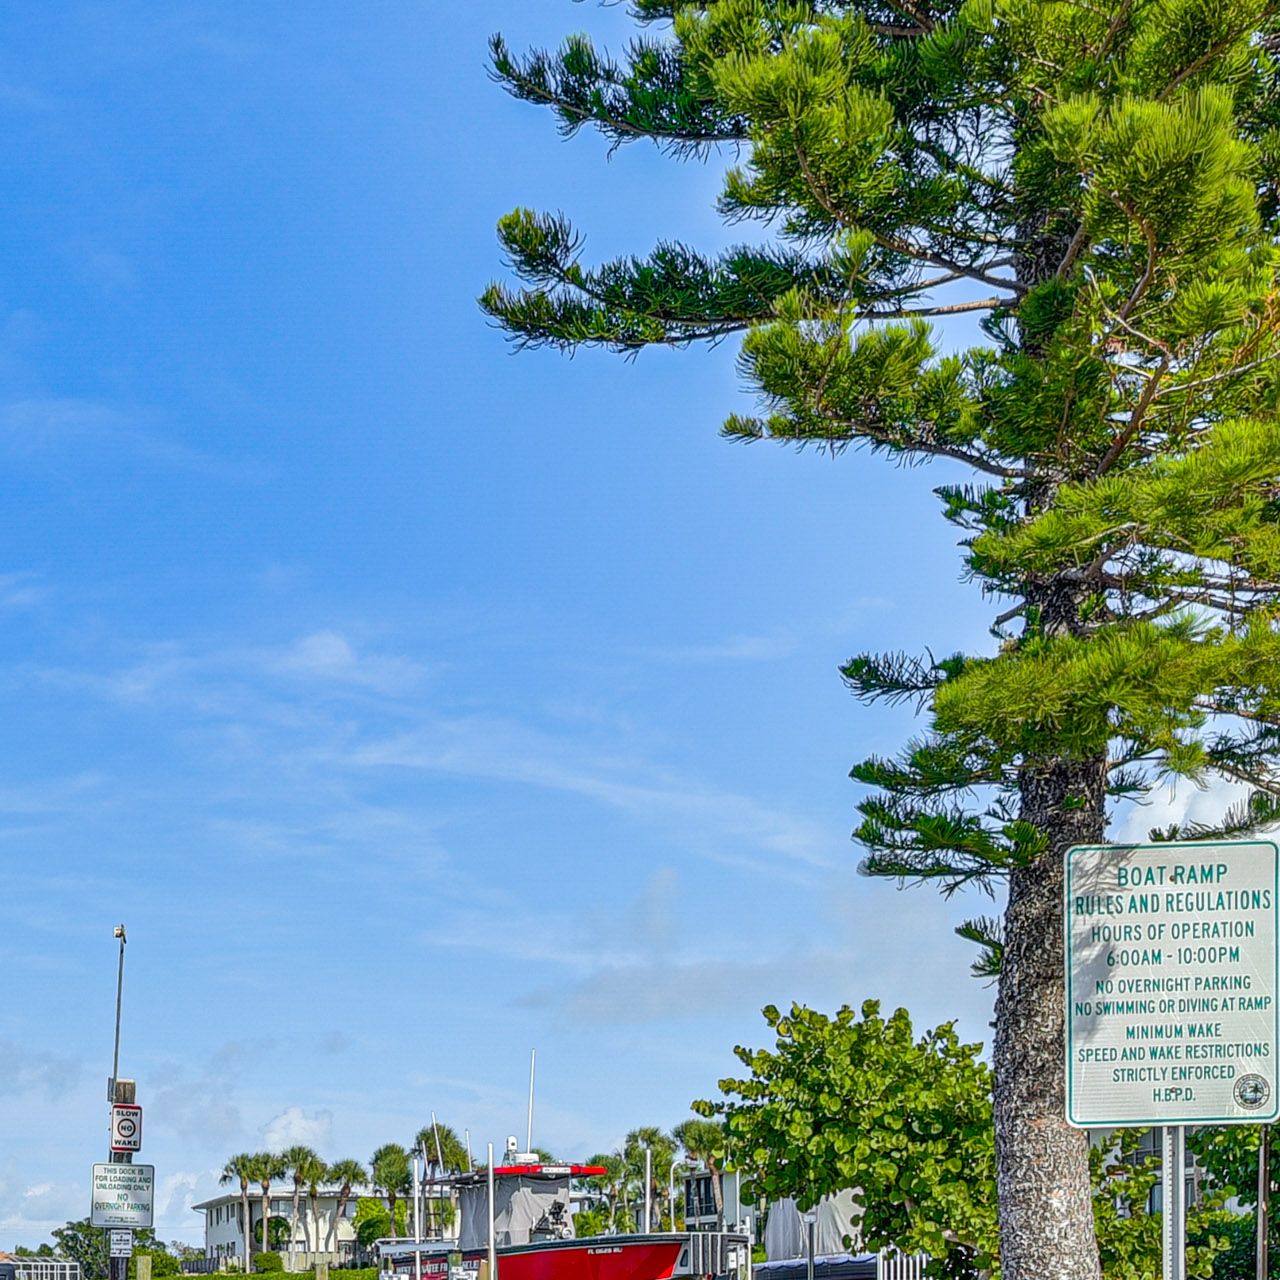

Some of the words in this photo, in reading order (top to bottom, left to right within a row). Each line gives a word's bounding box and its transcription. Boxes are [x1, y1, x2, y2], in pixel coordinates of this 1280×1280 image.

[1118, 866, 1166, 886] BOAT
[1174, 864, 1228, 885] RAMP
[1075, 895, 1123, 915] RULES
[1128, 893, 1159, 914] AND
[1166, 890, 1271, 912] REGULATIONS
[1092, 925, 1142, 942] HOURS
[1147, 924, 1166, 940] OF
[1171, 921, 1254, 939] OPERATION
[1107, 949, 1162, 966] 6:00AM
[1178, 946, 1239, 964] 10:00PM
[1096, 980, 1113, 994] NO
[1118, 977, 1190, 993] OVERNIGHT
[1195, 976, 1251, 991] PARKING
[1075, 1002, 1091, 1016] NO
[1096, 1000, 1155, 1015] SWIMMING
[1159, 999, 1175, 1013] OR
[1179, 998, 1218, 1012] DIVING
[1221, 998, 1235, 1011] AT
[1238, 996, 1271, 1010] RAMP
[1126, 1024, 1183, 1039] MINIMUM
[1187, 1023, 1222, 1037] WAKE
[1078, 1048, 1117, 1062] SPEED
[1121, 1047, 1145, 1060] AND
[1149, 1046, 1181, 1060] WAKE
[1186, 1043, 1270, 1059] RESTRICTIONS
[1113, 1067, 1168, 1082] STRICTLY
[1171, 1065, 1235, 1080] ENFORCED
[1153, 1088, 1196, 1102] H.B.P.D.
[117, 1193, 128, 1201] NO
[95, 1202, 125, 1210] OVERNIGHT
[127, 1203, 150, 1211] PARKING
